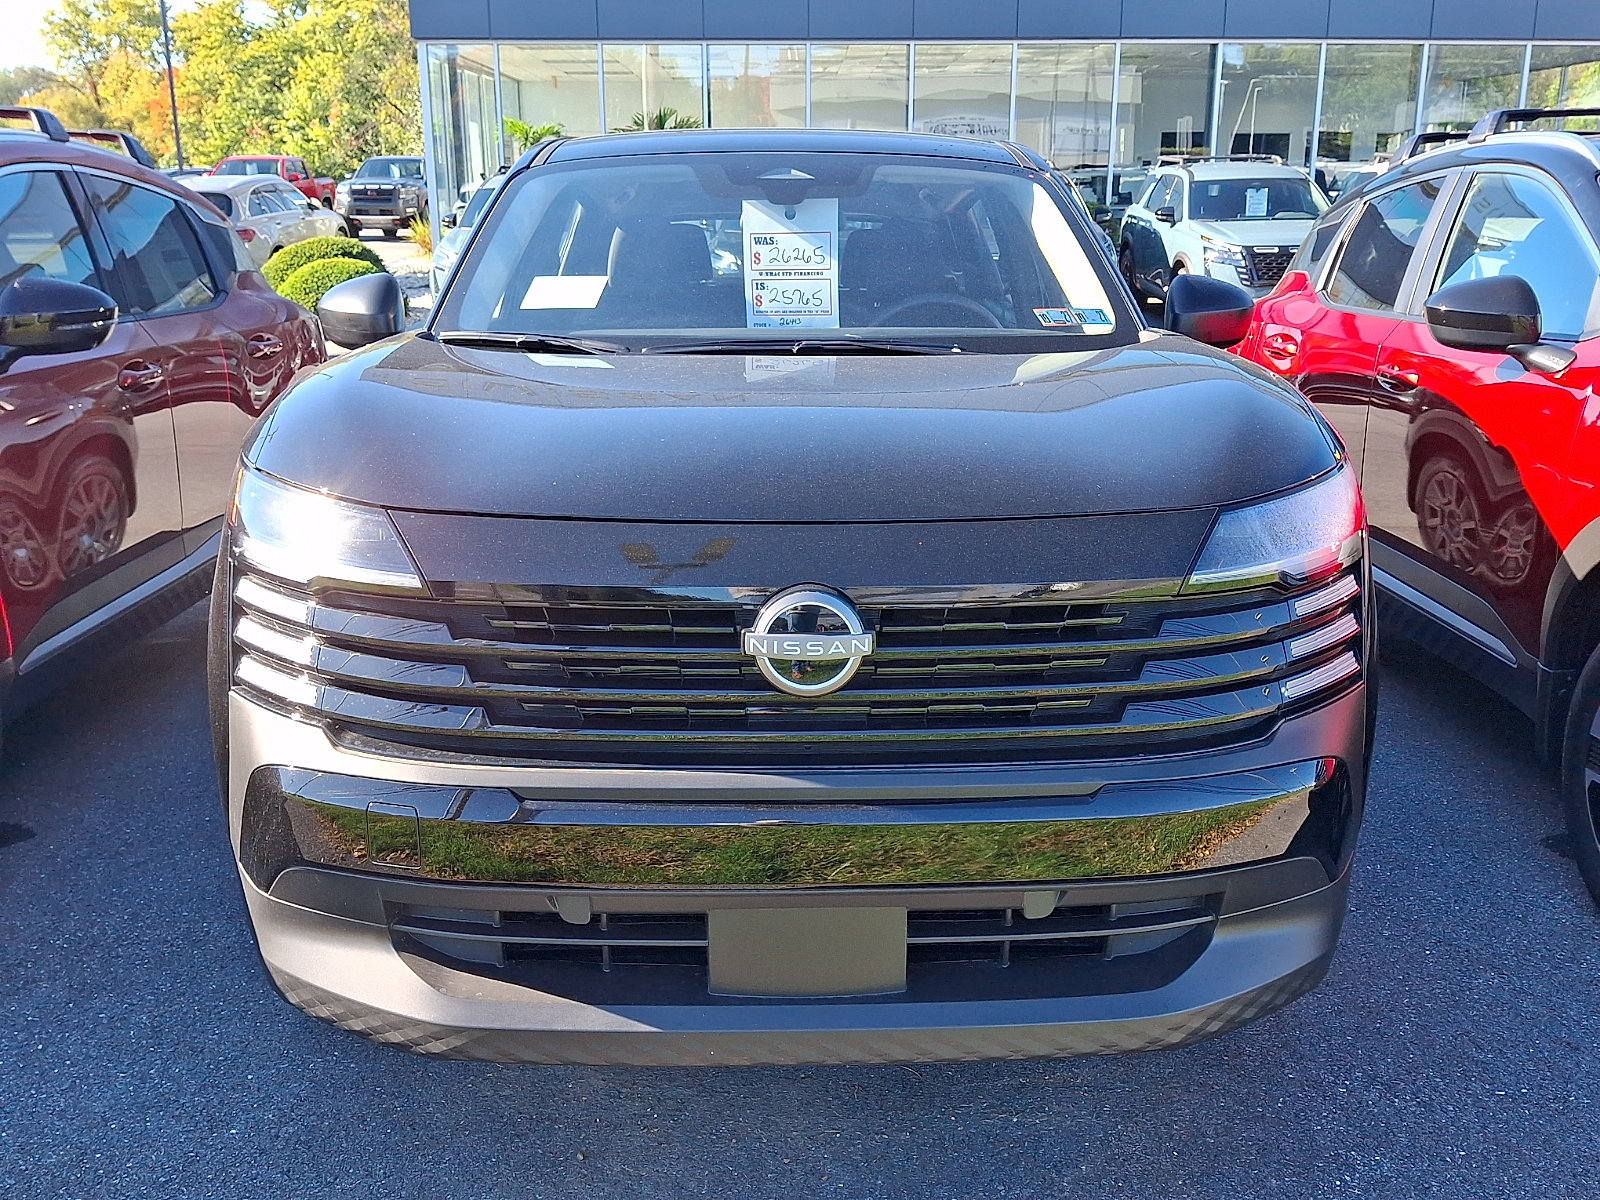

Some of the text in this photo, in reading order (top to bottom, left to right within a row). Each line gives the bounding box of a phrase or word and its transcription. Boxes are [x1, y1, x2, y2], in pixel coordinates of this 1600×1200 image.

[753, 237, 779, 245] WAS:
[753, 245, 825, 266] $ 26265
[755, 282, 769, 291] IS:
[755, 287, 823, 308] $ 25765
[749, 638, 869, 656] NISSAN
